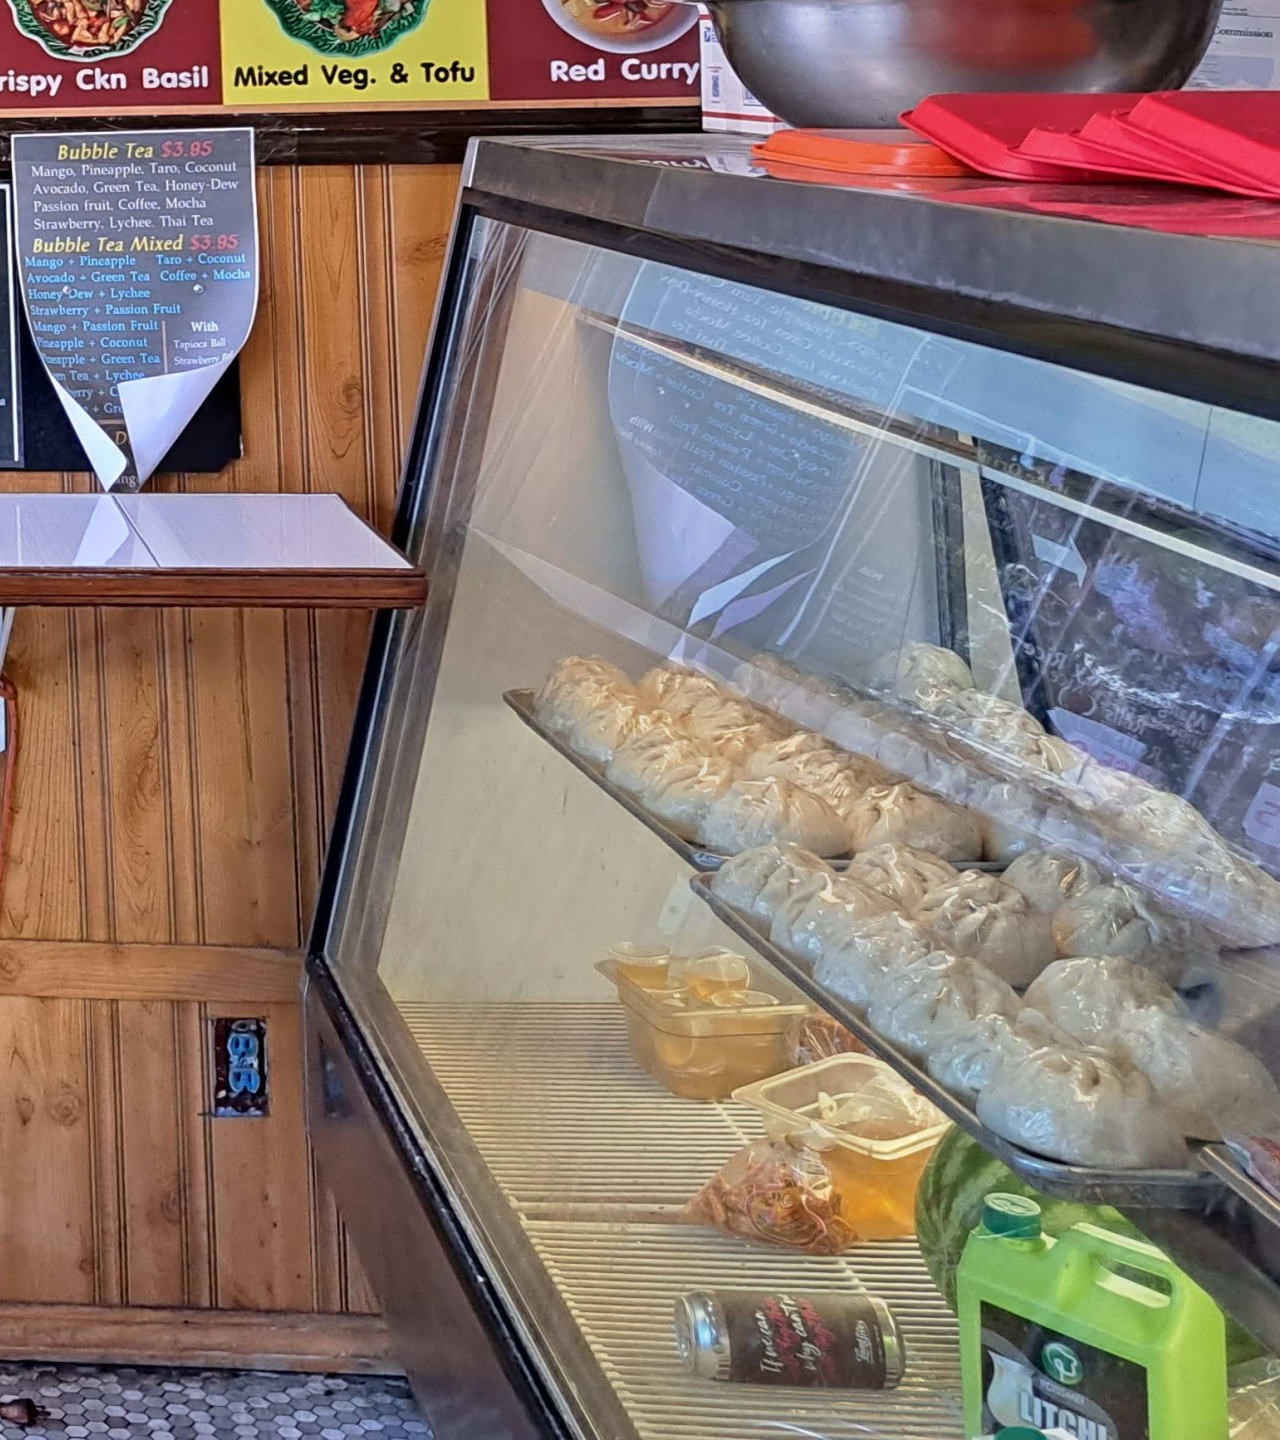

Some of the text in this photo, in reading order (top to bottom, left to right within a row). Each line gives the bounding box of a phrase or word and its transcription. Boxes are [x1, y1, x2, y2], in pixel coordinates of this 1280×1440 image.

[77, 68, 126, 90] Ckn
[142, 67, 208, 89] Basil
[234, 61, 475, 89] Mixed Veg. & Tofu
[551, 58, 699, 86] Red Curry
[58, 143, 118, 160] Bubble
[126, 143, 153, 158] Tea
[34, 201, 78, 212] Passion
[166, 198, 206, 209] Mocha
[33, 236, 90, 253] Bubble
[97, 237, 123, 252] Tea
[131, 234, 183, 251] Mixed
[191, 322, 218, 332] With
